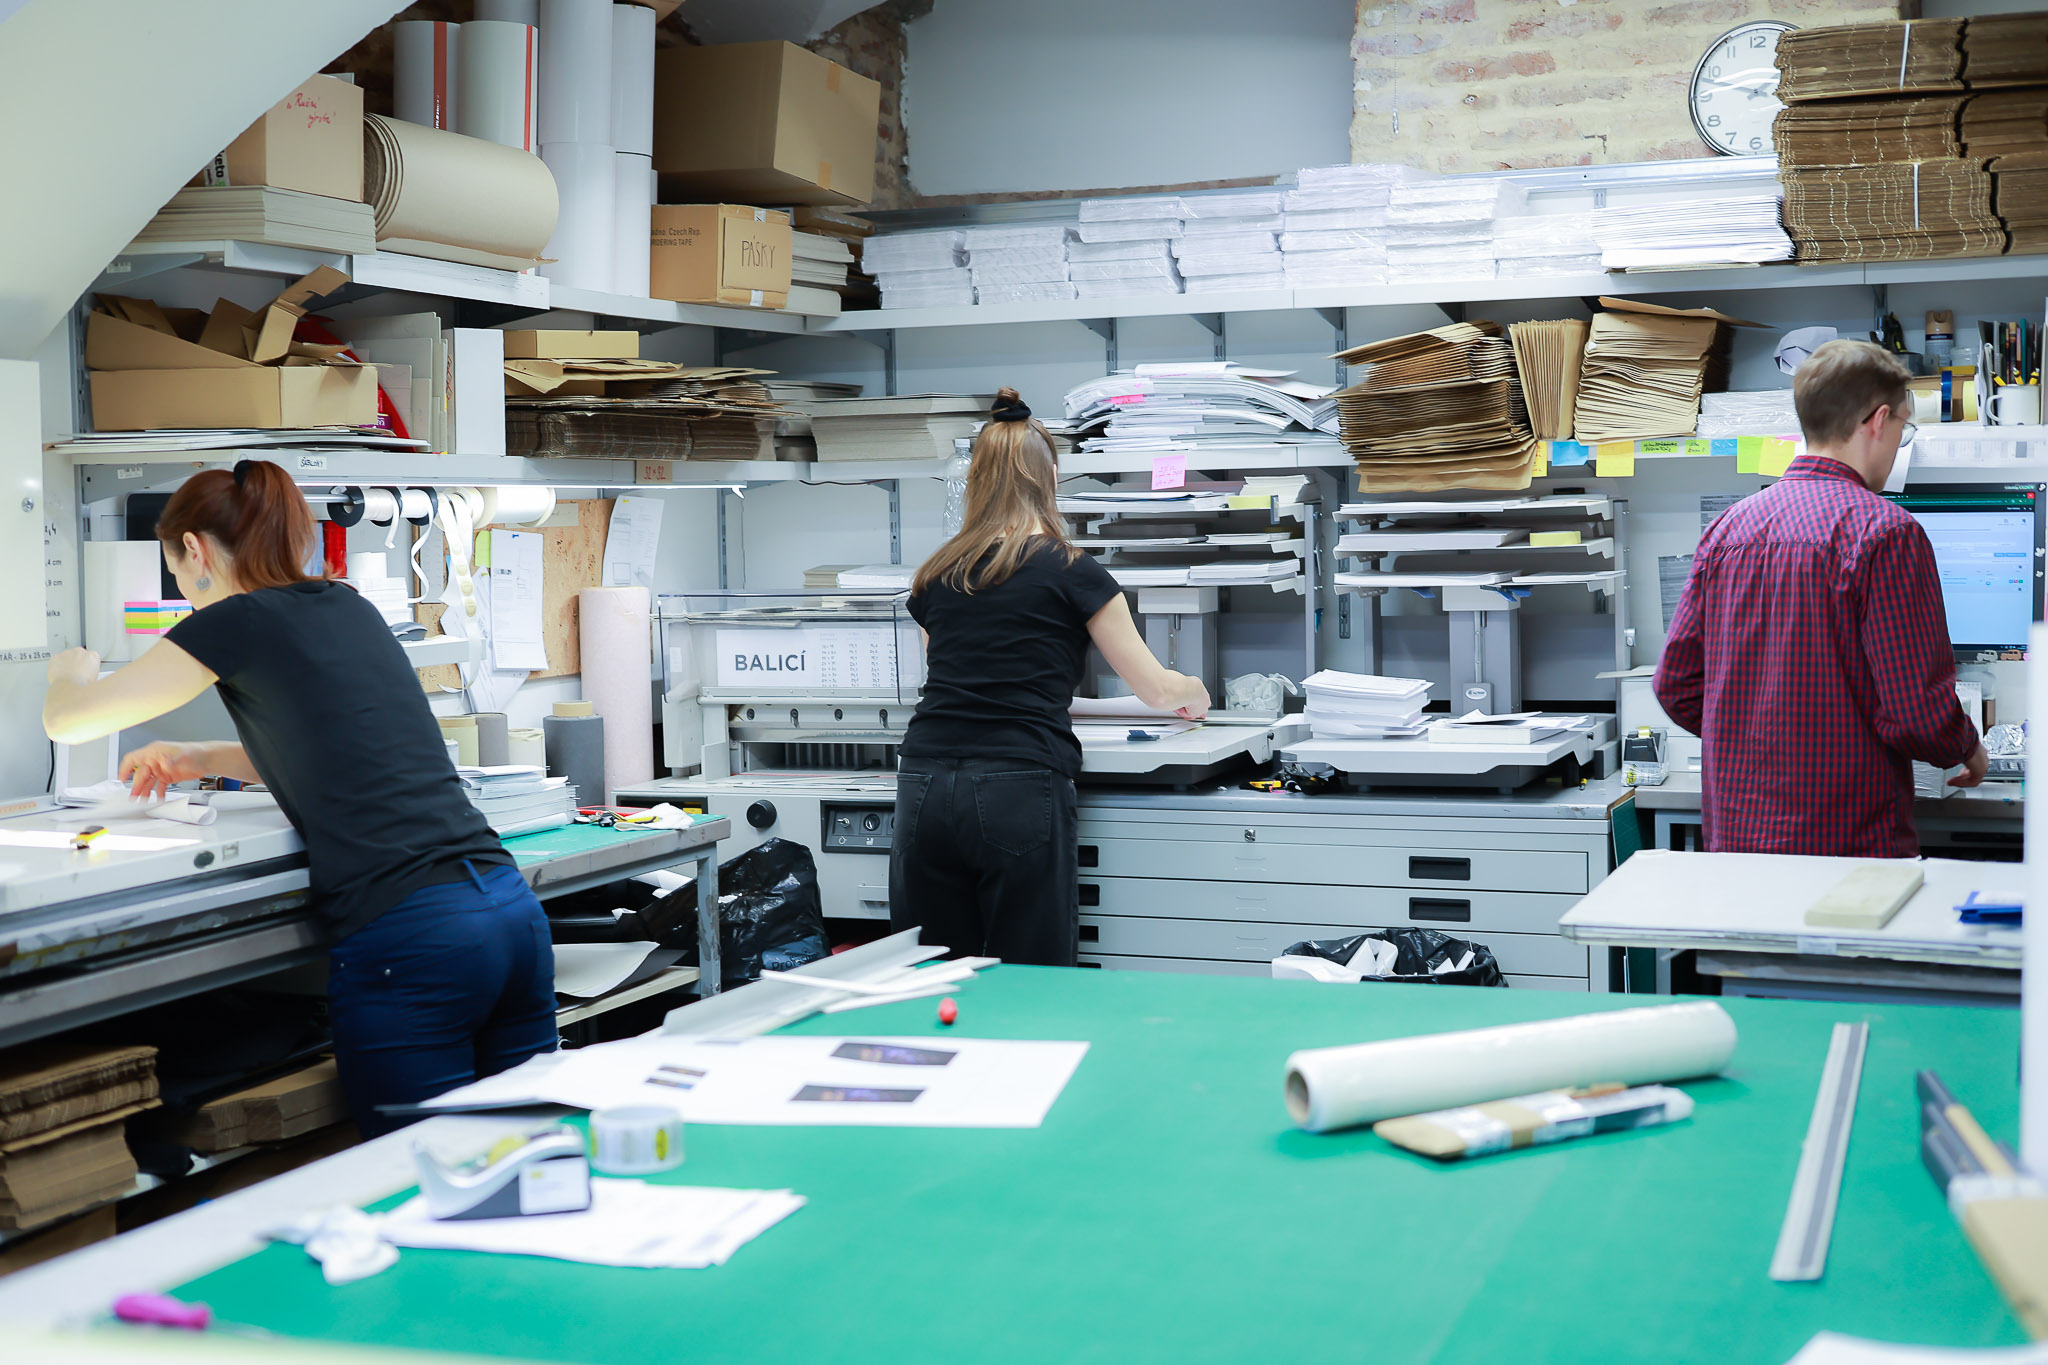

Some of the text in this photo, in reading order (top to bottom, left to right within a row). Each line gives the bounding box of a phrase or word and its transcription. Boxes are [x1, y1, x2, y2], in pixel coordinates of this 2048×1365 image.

[1750, 35, 1766, 48] 12
[1726, 46, 1736, 58] 11
[1708, 65, 1721, 78] 10
[1707, 114, 1721, 127] 8
[1725, 131, 1737, 145] 7
[1749, 137, 1762, 150] 6
[669, 227, 687, 236] Czech
[679, 238, 692, 246] TAPE
[735, 650, 806, 672] BALICÍ
